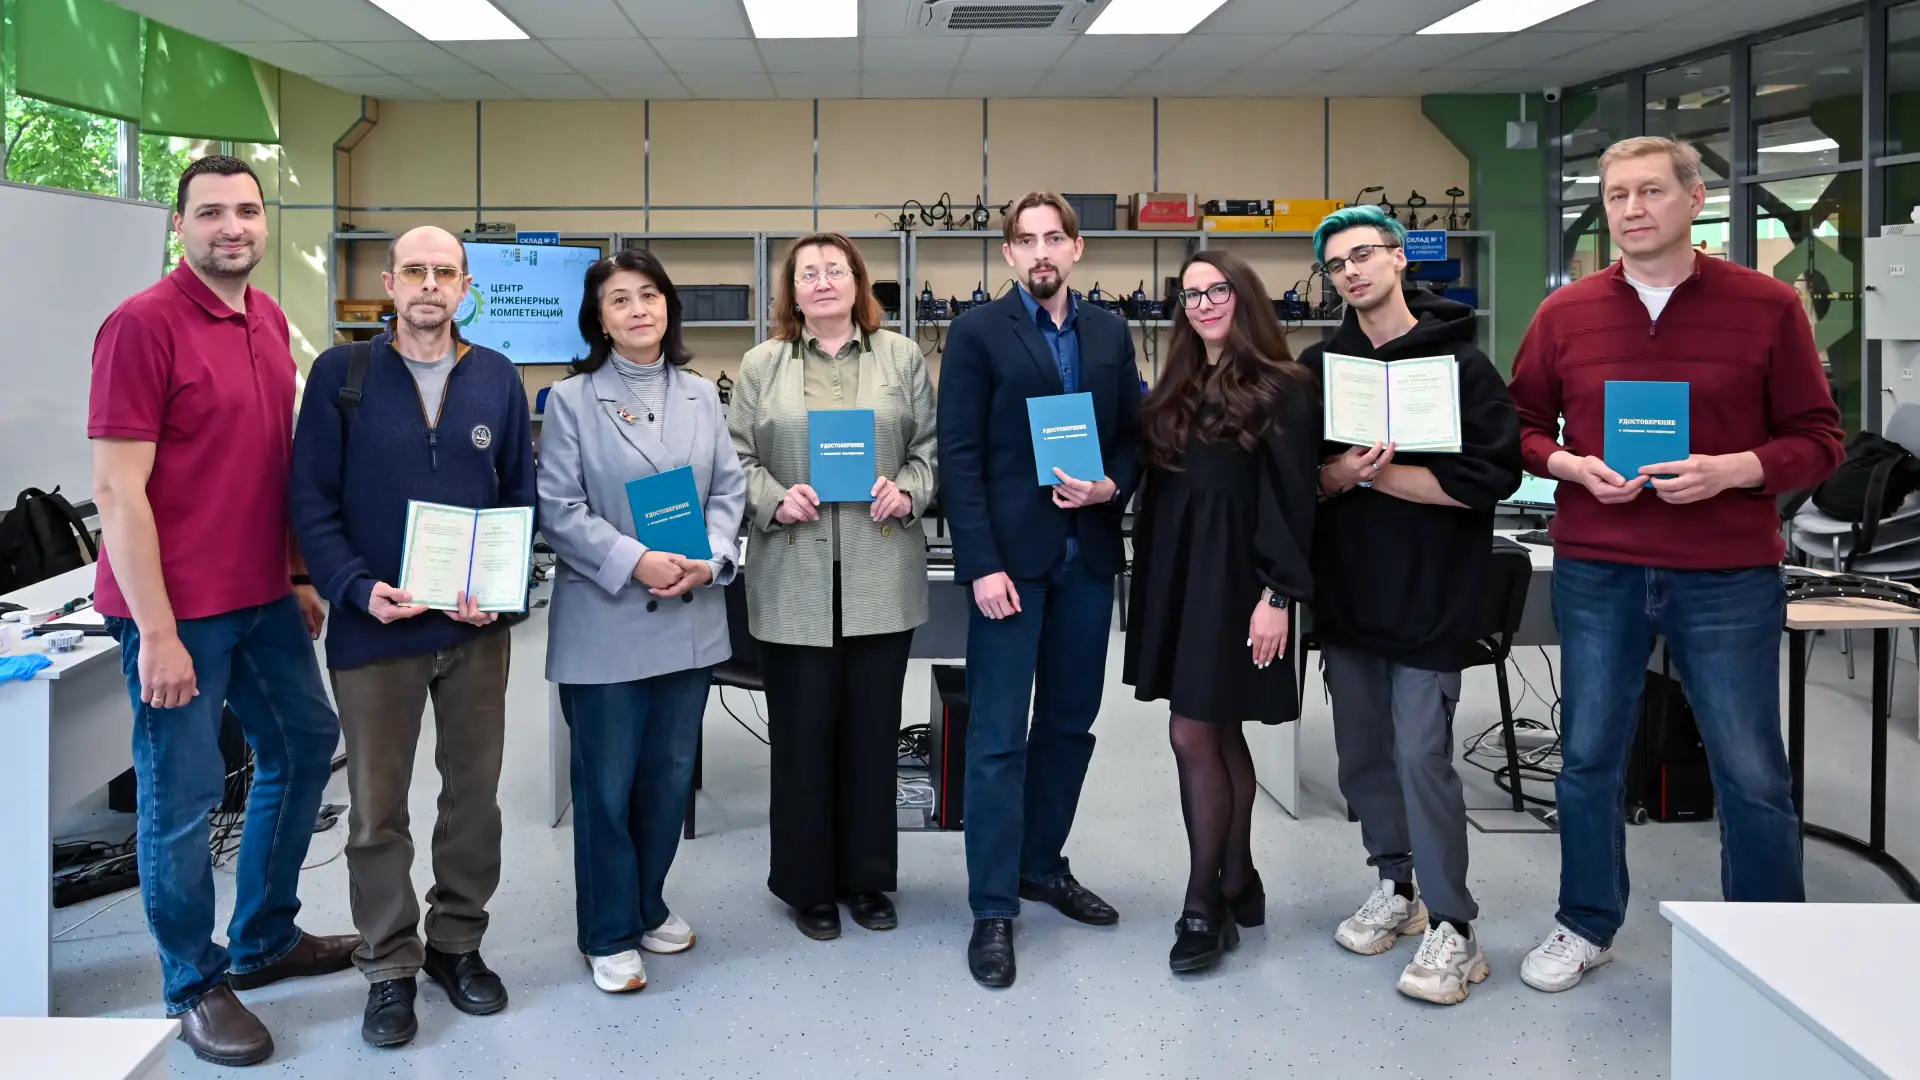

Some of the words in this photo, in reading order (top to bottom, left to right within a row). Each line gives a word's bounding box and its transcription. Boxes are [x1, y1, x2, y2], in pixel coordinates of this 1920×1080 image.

[490, 284, 523, 293] ЦЕНТР
[490, 296, 560, 305] ИНЖЕНЕРНЫХ
[490, 308, 563, 318] КОМПЕТЕНЦИЙ
[1042, 424, 1086, 433] УДОСТОВЕРЕНИЕ
[644, 502, 689, 518] УДОСТОВЕРЕНИЕ
